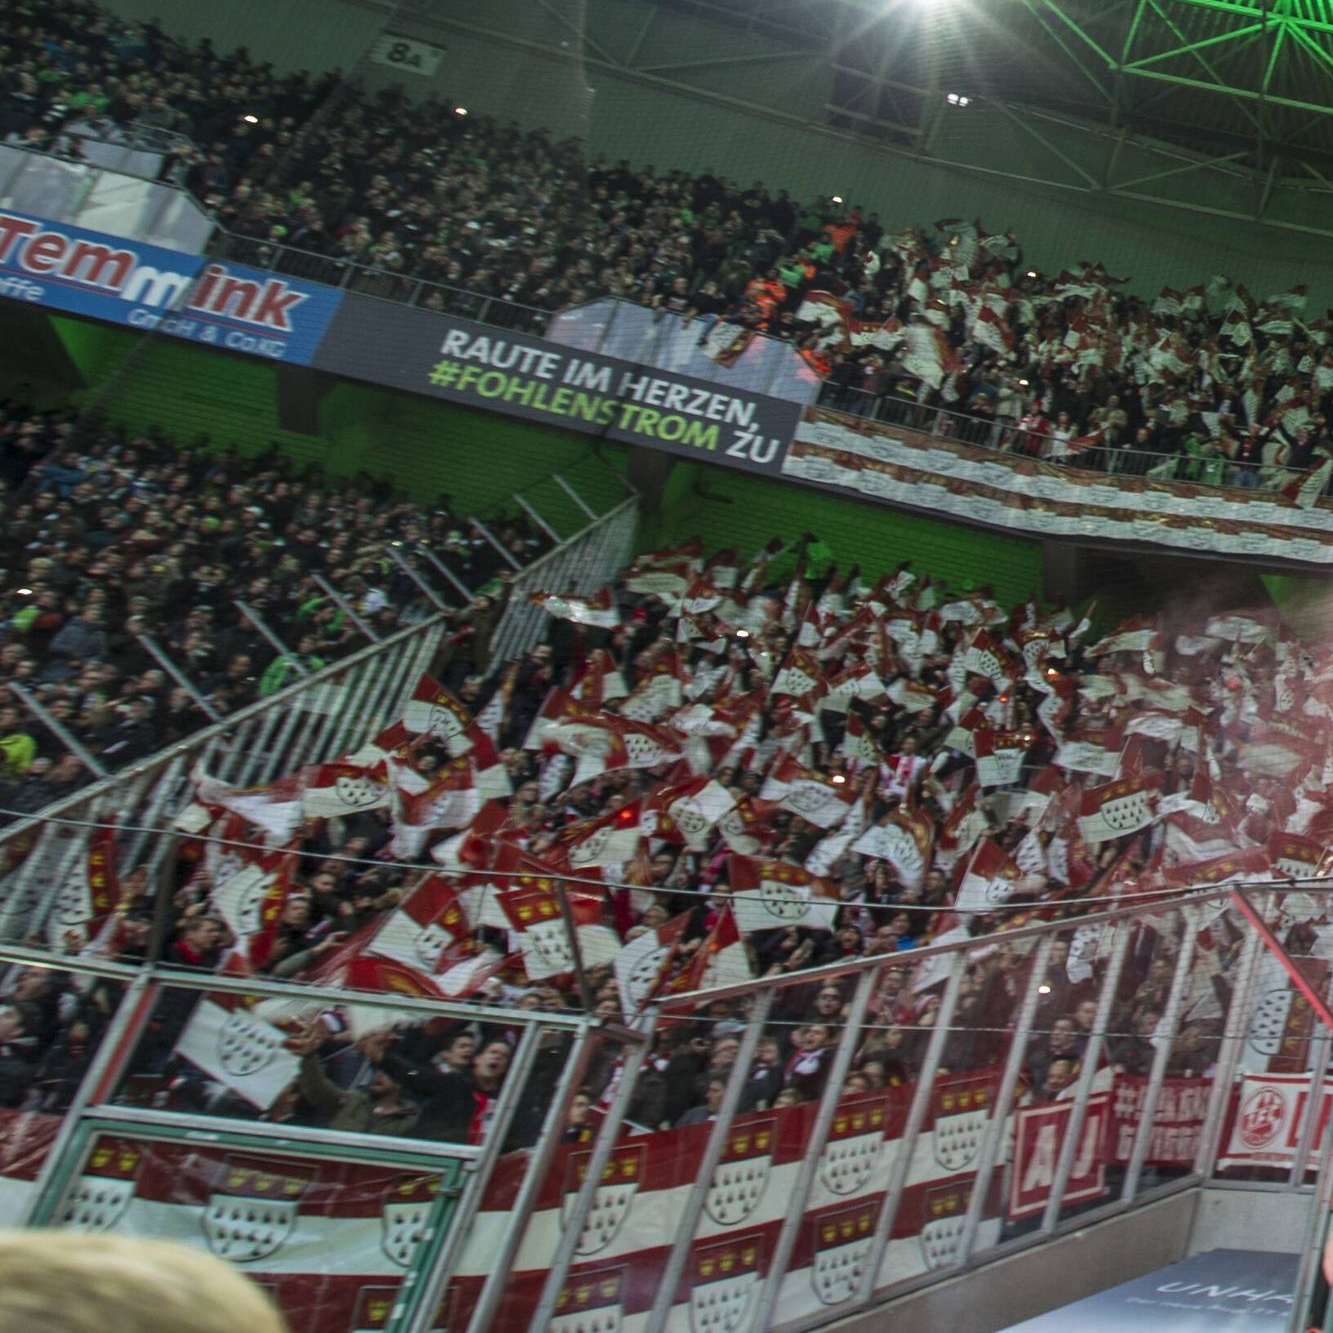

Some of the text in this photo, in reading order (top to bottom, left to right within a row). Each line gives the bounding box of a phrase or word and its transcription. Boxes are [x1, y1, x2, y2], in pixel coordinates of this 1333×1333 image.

[386, 42, 422, 67] 8A
[428, 360, 780, 464] #FOHLENSTROM ZU
[440, 329, 760, 434] RAUTE IM HERZEN,
